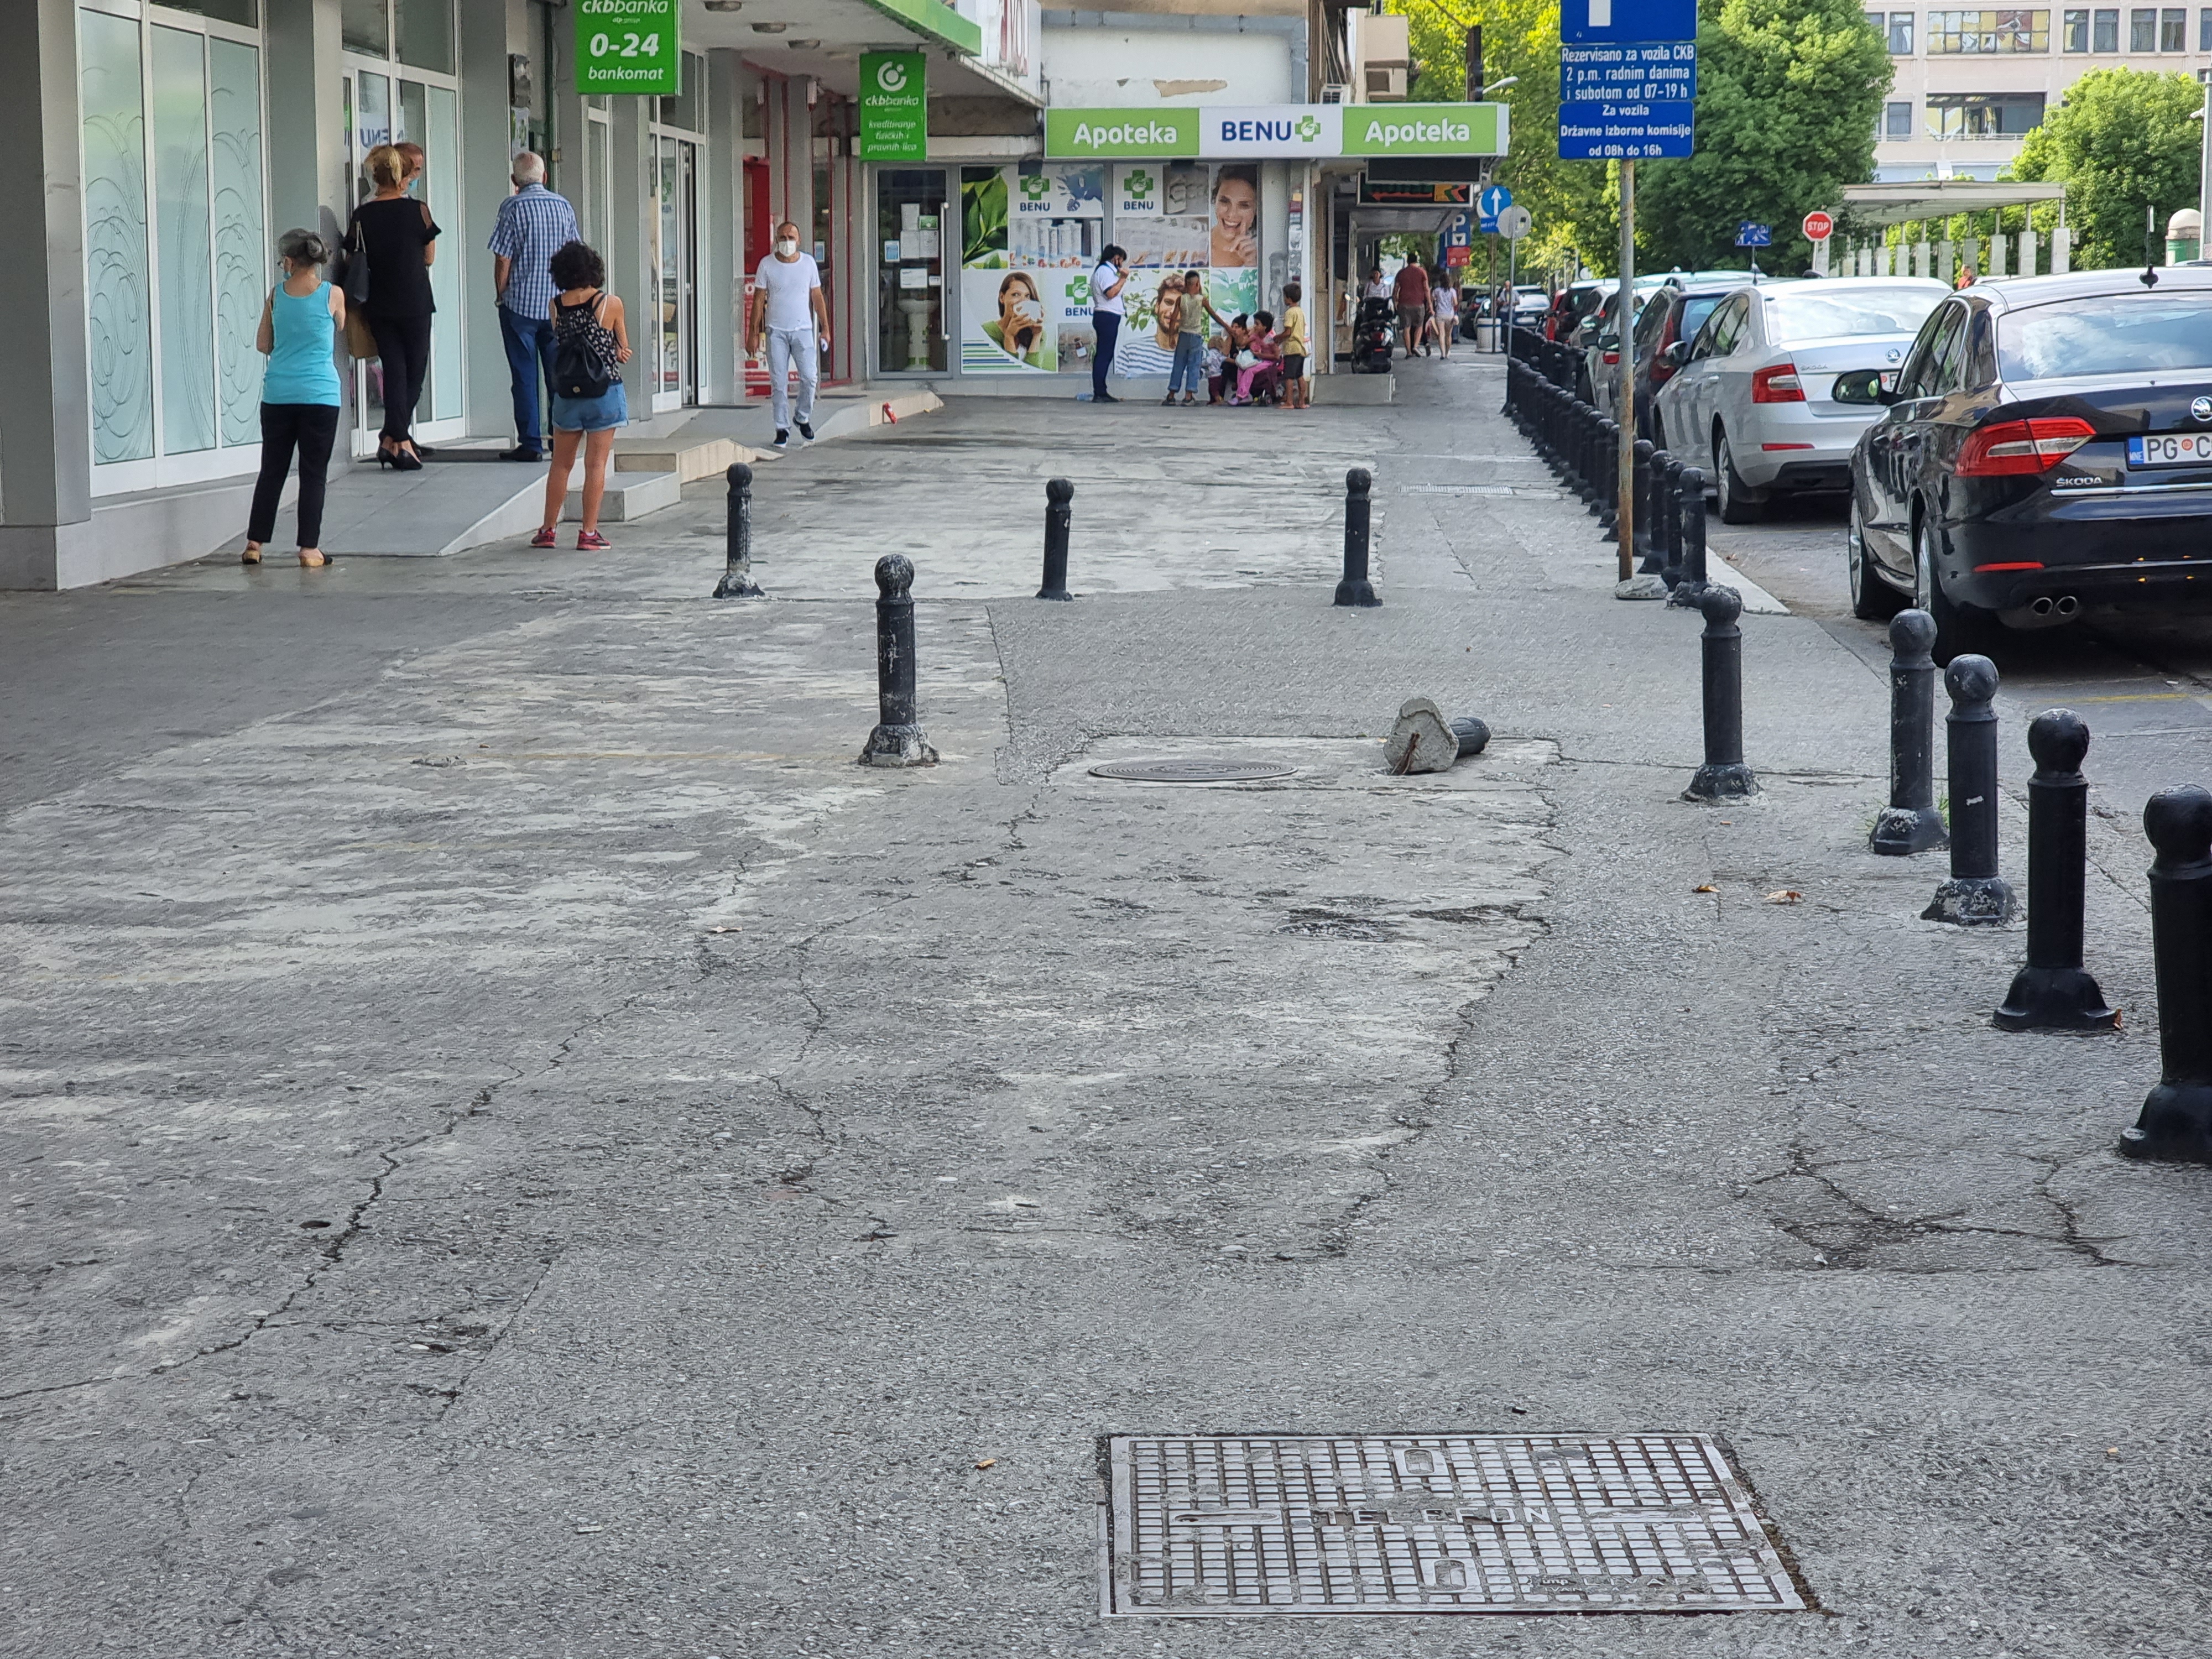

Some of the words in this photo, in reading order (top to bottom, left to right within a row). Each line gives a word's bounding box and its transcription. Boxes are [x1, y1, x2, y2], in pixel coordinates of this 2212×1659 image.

[582, 0, 668, 13] ckbbanka
[590, 33, 659, 57] 0-24
[1562, 47, 1622, 62] Rezervisano
[1625, 49, 1637, 61] za
[1641, 45, 1670, 61] vozila
[1673, 45, 1694, 60] CKB
[588, 66, 664, 80] bankomat
[1566, 66, 1573, 82] 2
[1578, 70, 1601, 85] p.m.
[1606, 65, 1645, 81] radnim
[1649, 64, 1689, 79] danima
[1567, 86, 1570, 100] i
[1575, 85, 1622, 100] subotom
[1626, 84, 1640, 99] od
[1645, 83, 1677, 98] 07-19
[1681, 82, 1688, 98] h
[865, 95, 919, 106] ckbbanka
[1602, 104, 1616, 116] Za
[1619, 103, 1649, 116] vozila
[1073, 120, 1177, 150] Apoteka
[1221, 121, 1292, 142] BENU
[1364, 117, 1471, 147] Apoteka
[1561, 124, 1603, 137] Državne
[1647, 123, 1691, 138] komisije
[1588, 144, 1601, 156] od
[1604, 144, 1624, 156] 08h
[1626, 144, 1640, 156] do
[1643, 144, 1662, 156] 16h
[1020, 202, 1051, 212] BENU
[1123, 200, 1154, 211] BENU
[1452, 213, 1466, 232] P
[1807, 221, 1829, 231] STOP
[1065, 306, 1094, 316] BENU
[2147, 437, 2178, 462] PG
[2056, 477, 2103, 487] ŠKODA
[1316, 1507, 1551, 1525] TELEFON
